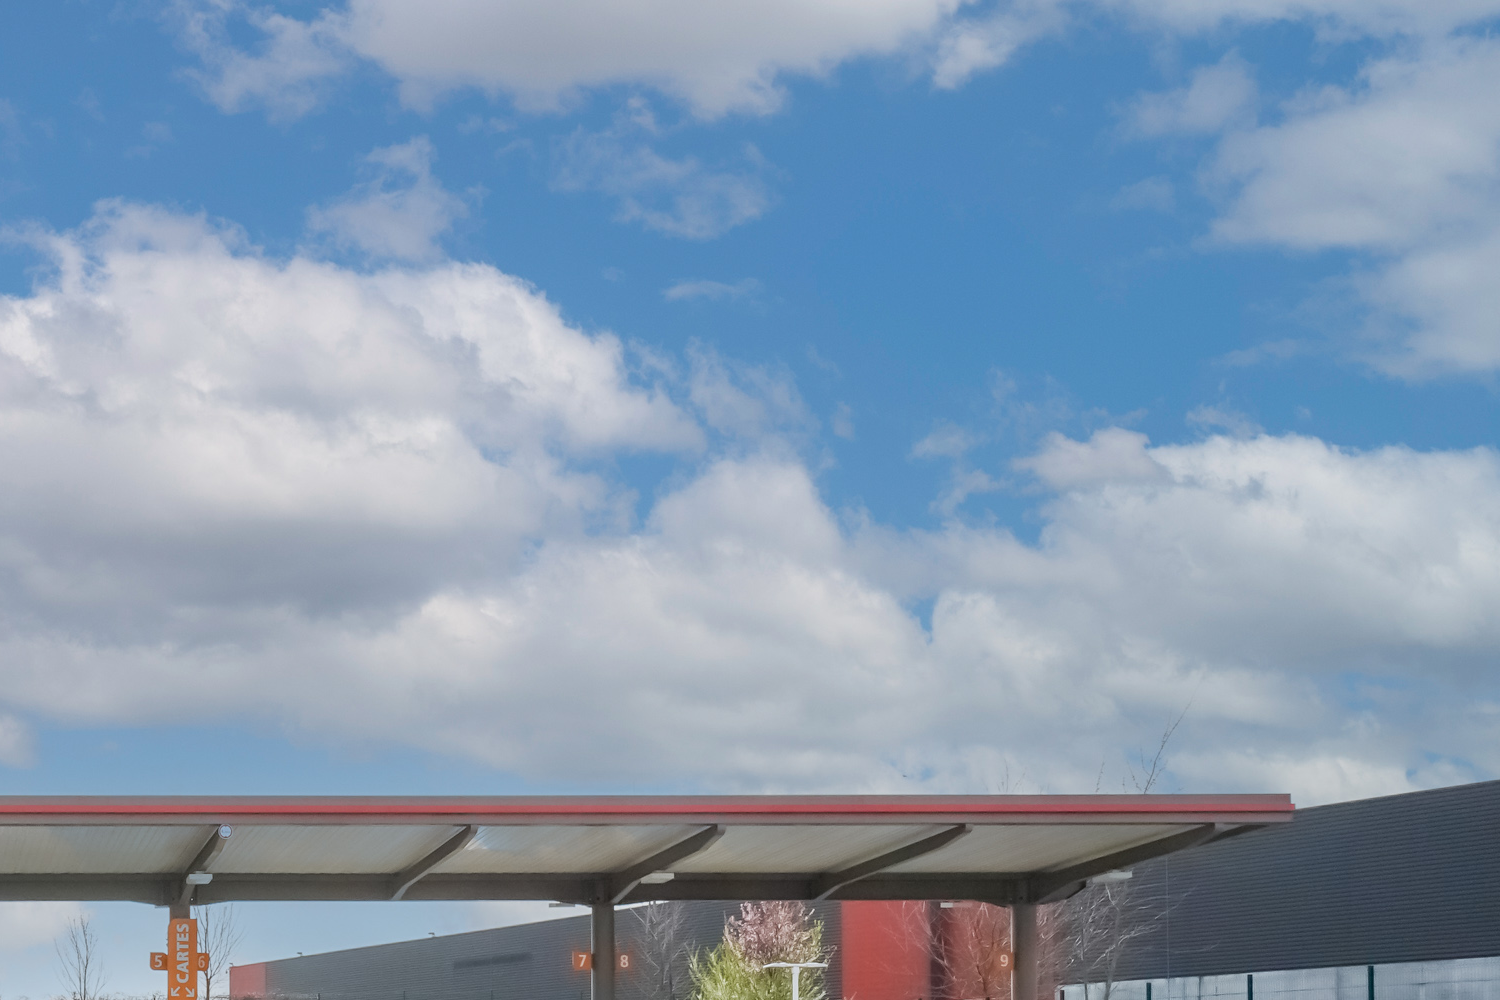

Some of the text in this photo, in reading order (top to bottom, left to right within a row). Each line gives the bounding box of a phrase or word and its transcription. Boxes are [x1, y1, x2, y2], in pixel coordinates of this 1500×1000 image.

[176, 924, 189, 983] CARTES
[154, 955, 162, 968] 5
[198, 956, 205, 968] 6
[579, 955, 586, 967] 7
[620, 955, 628, 967] 8
[1000, 954, 1008, 967] 9
